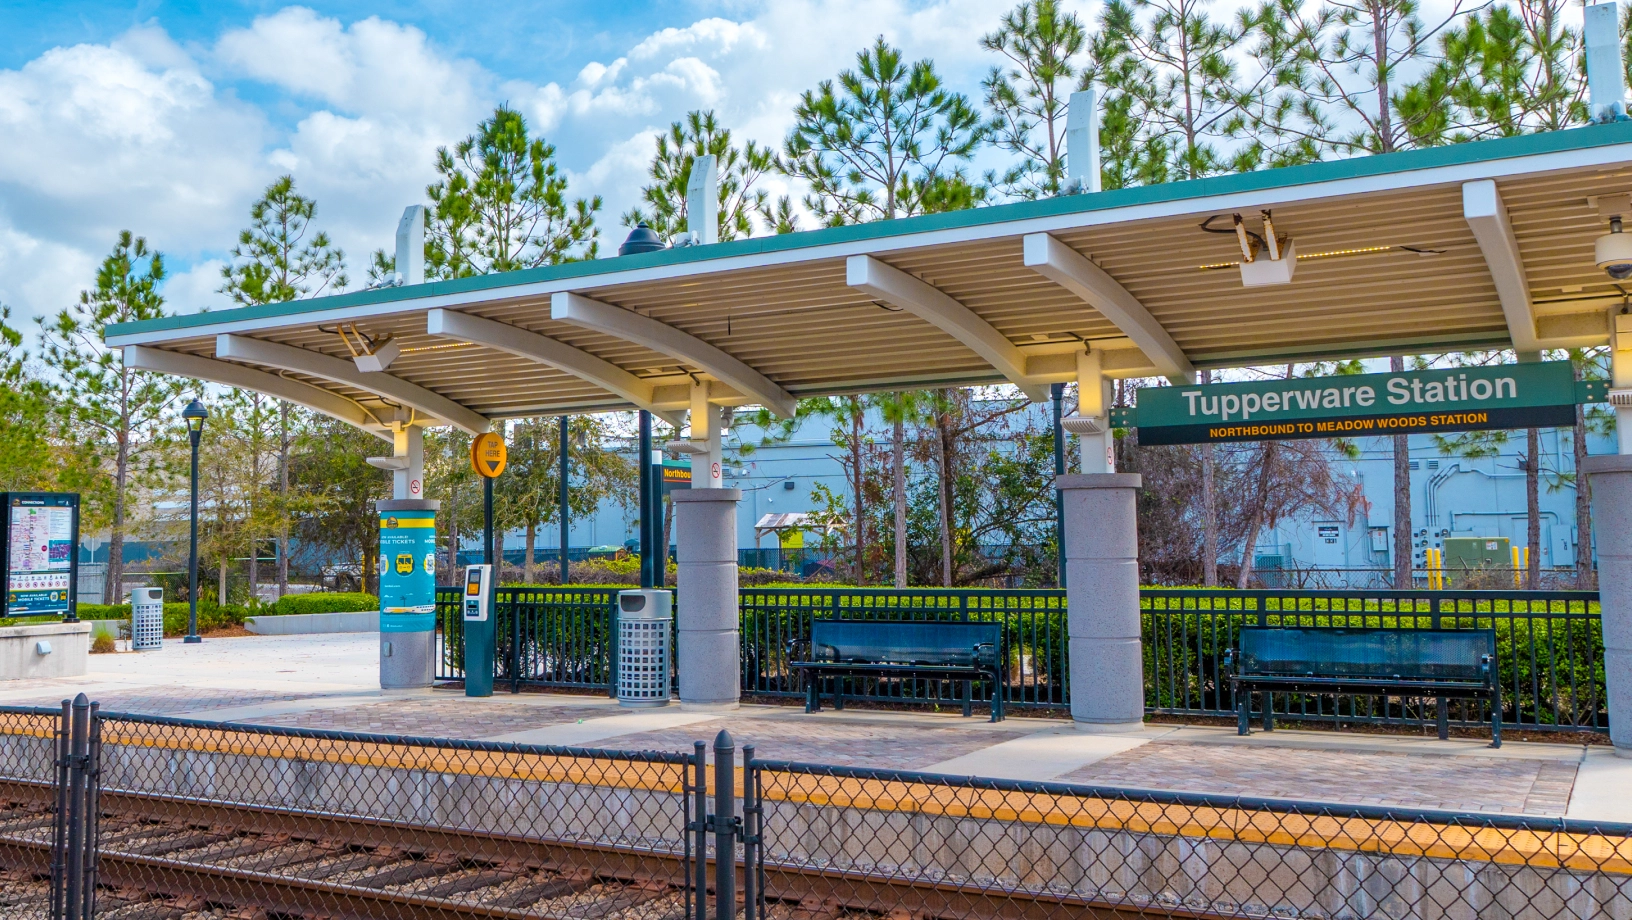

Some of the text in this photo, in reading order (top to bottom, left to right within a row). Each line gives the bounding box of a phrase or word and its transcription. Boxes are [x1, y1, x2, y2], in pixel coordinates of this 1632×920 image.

[1182, 373, 1517, 421] Tupperware Station
[1210, 412, 1487, 438] NORTHBOUND TO MEADOW WOODS STATION
